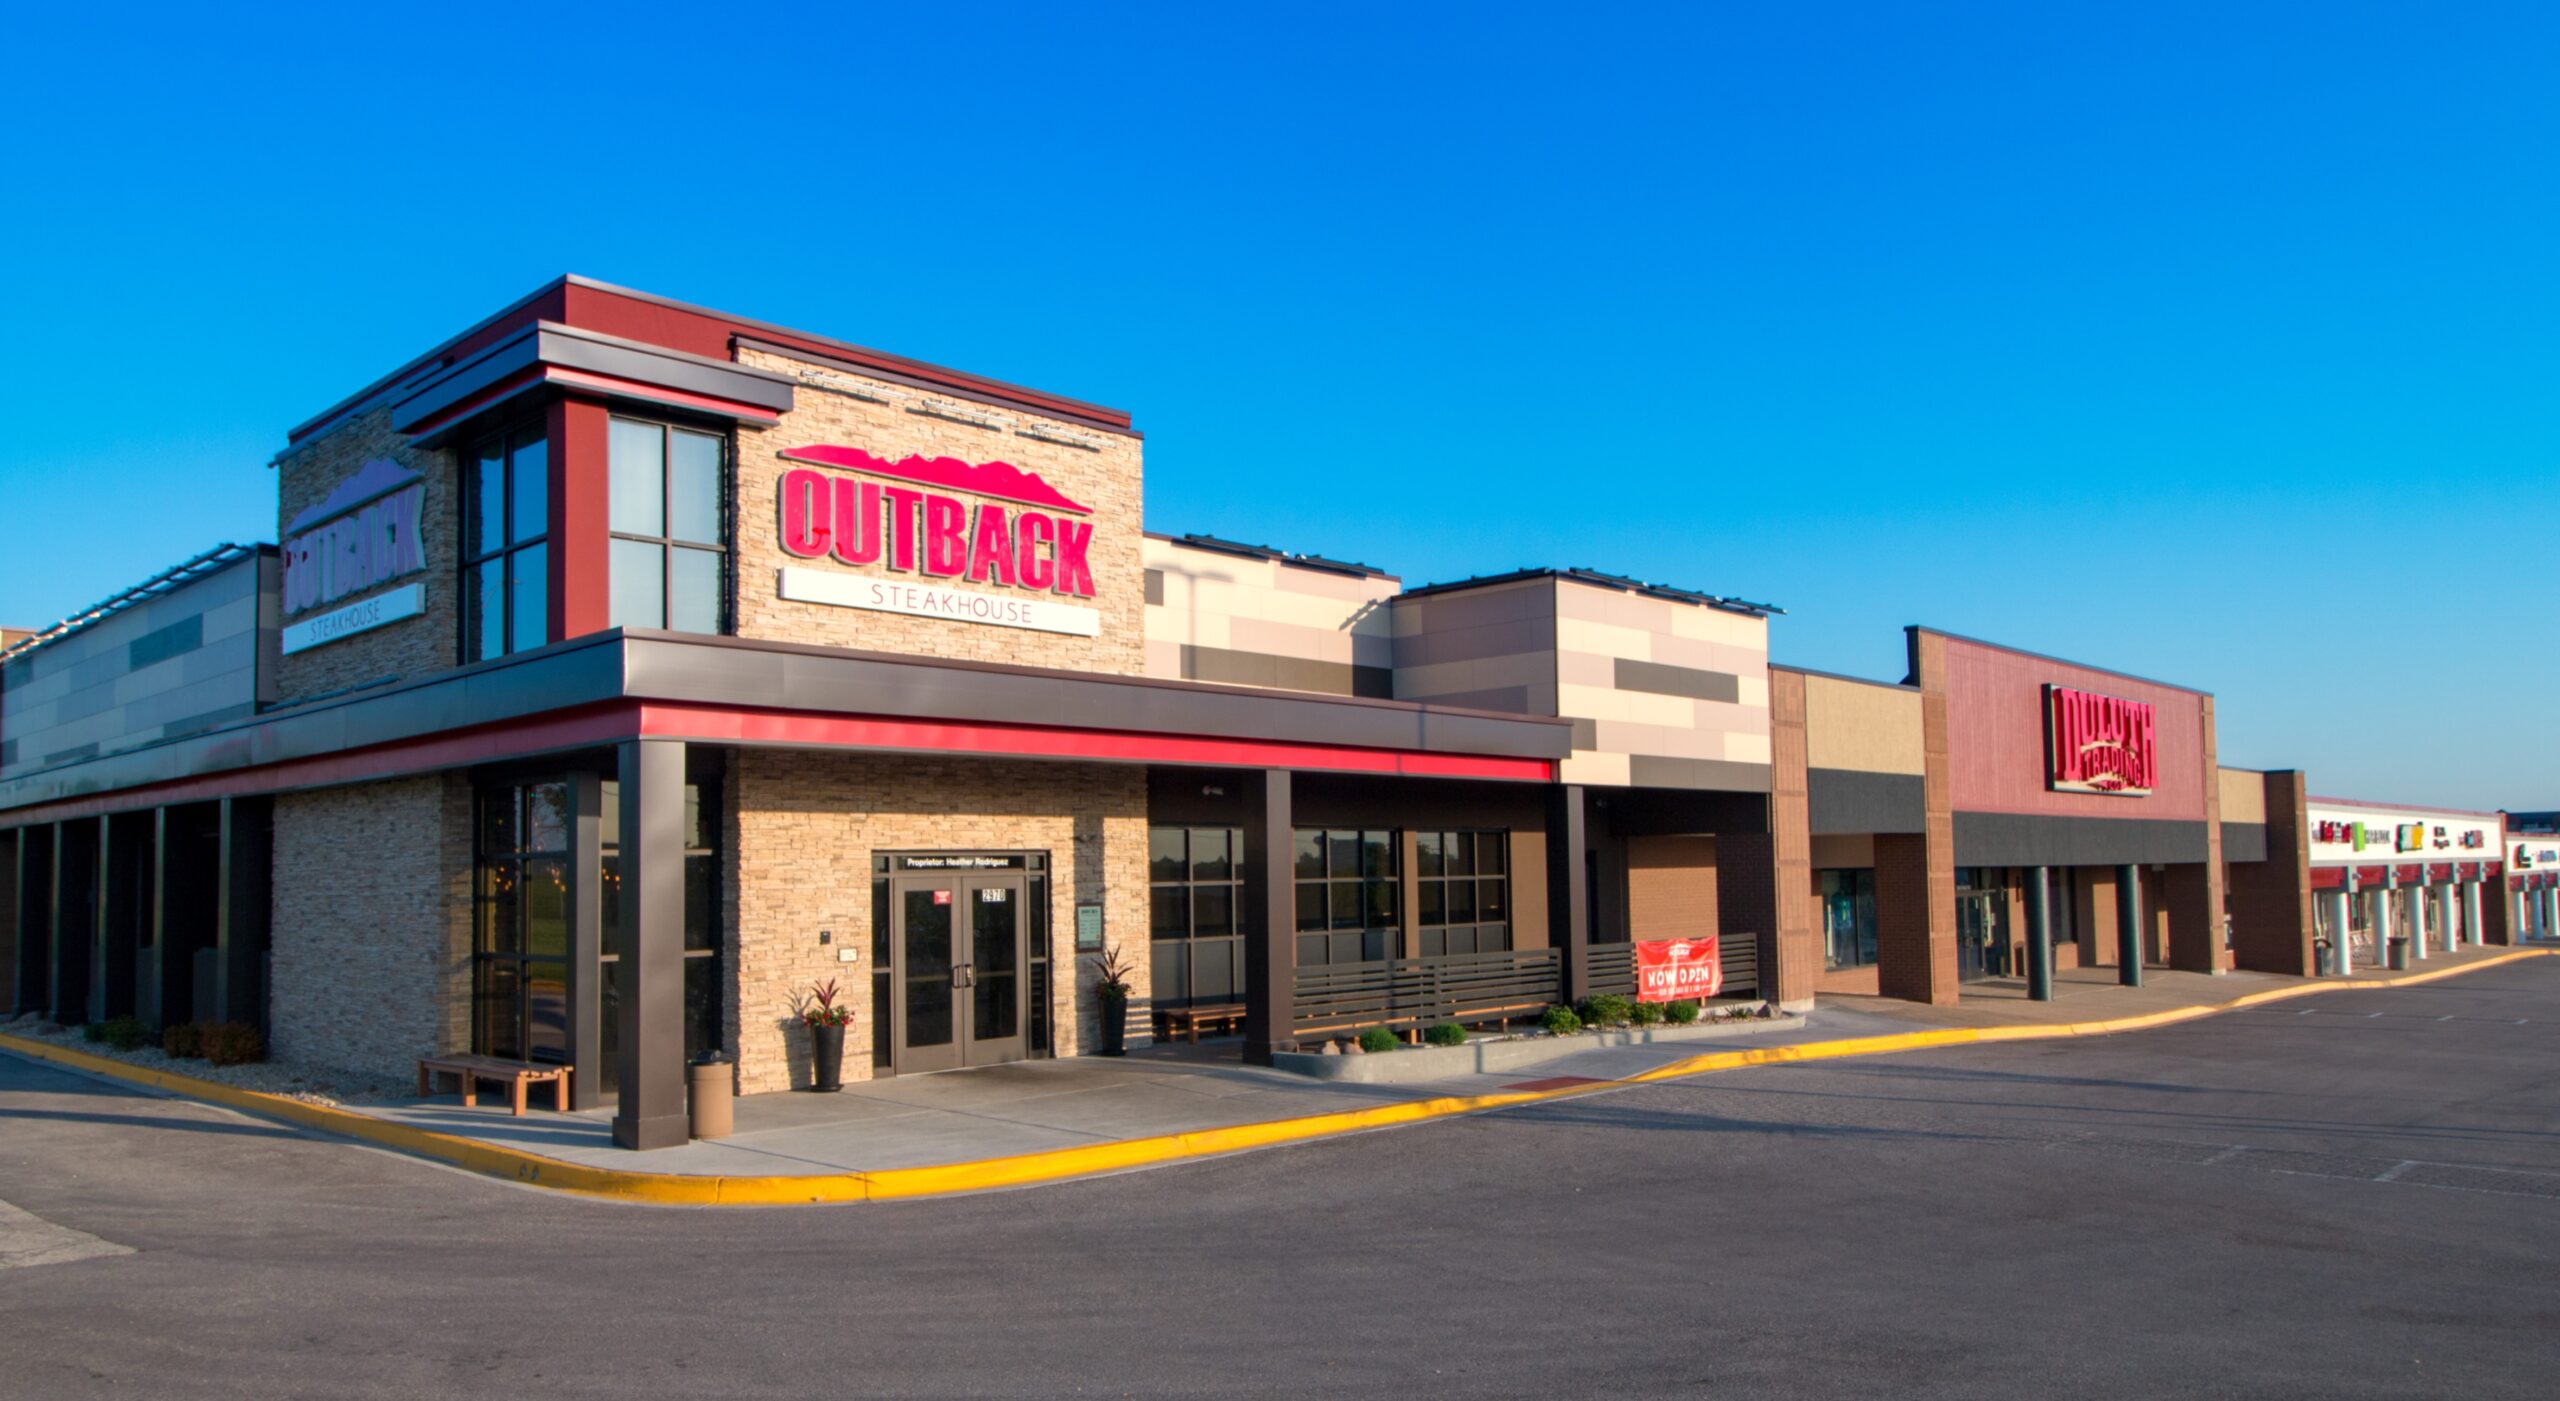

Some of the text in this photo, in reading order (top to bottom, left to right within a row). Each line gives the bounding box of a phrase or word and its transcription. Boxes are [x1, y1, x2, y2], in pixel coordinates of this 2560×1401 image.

[782, 468, 1097, 598] OUTBACK
[309, 599, 381, 643] STEAKHOUSE
[871, 583, 1033, 624] STEAKHOUSE
[2060, 687, 2159, 790] DULUTH
[2084, 745, 2142, 788] TRADING
[907, 857, 1009, 868] Proprietor: Heather Rodriguez
[983, 889, 1006, 902] 2970
[1647, 966, 1709, 987] NOW OPEN
